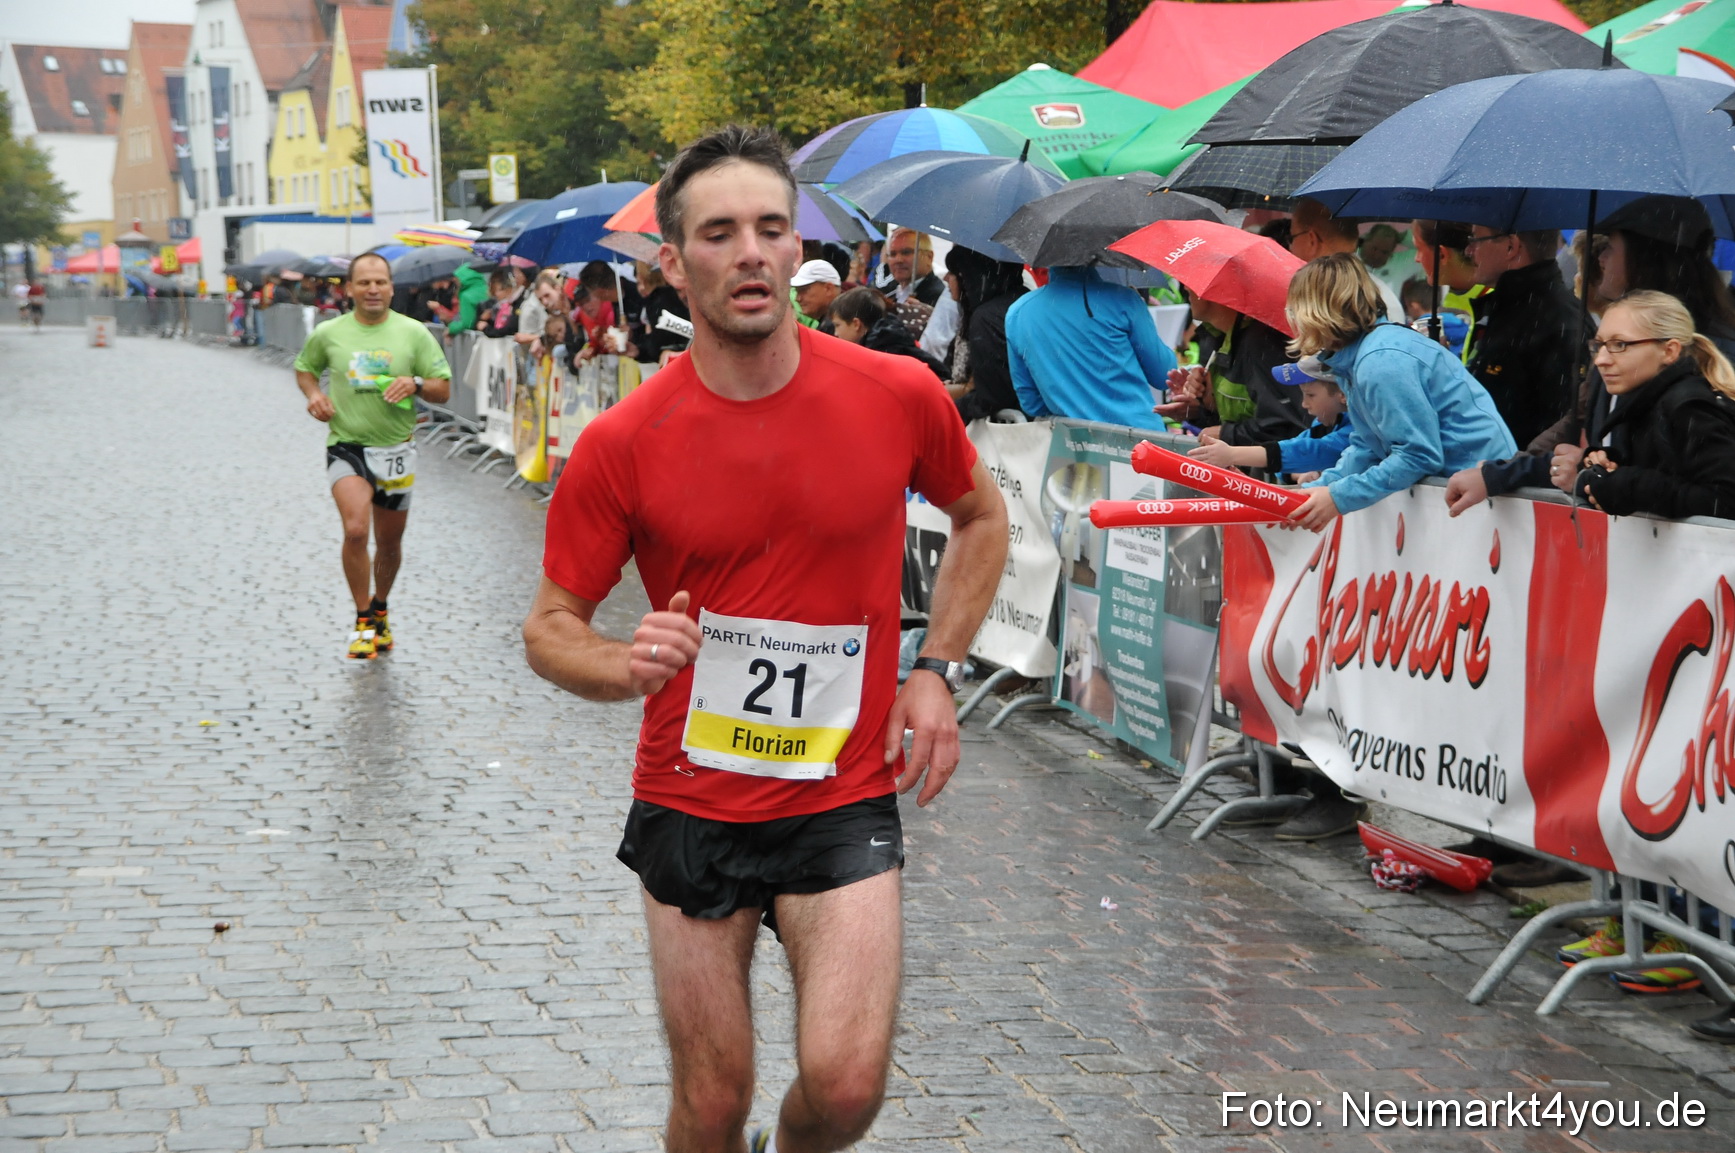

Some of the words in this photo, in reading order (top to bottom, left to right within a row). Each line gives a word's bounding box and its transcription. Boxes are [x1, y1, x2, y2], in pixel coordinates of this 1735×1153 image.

[1164, 236, 1206, 265] ESPRIT
[385, 456, 405, 477] 78
[1222, 477, 1251, 495] BKK
[1254, 487, 1288, 506] Audi
[1188, 501, 1220, 512] BKK
[1262, 512, 1501, 716] Charivari
[702, 625, 756, 647] PARTL
[760, 635, 837, 655] Neumarkt
[742, 658, 807, 718] 21
[697, 698, 704, 709] B
[732, 726, 807, 756] Florian
[1437, 743, 1507, 804] Radio
